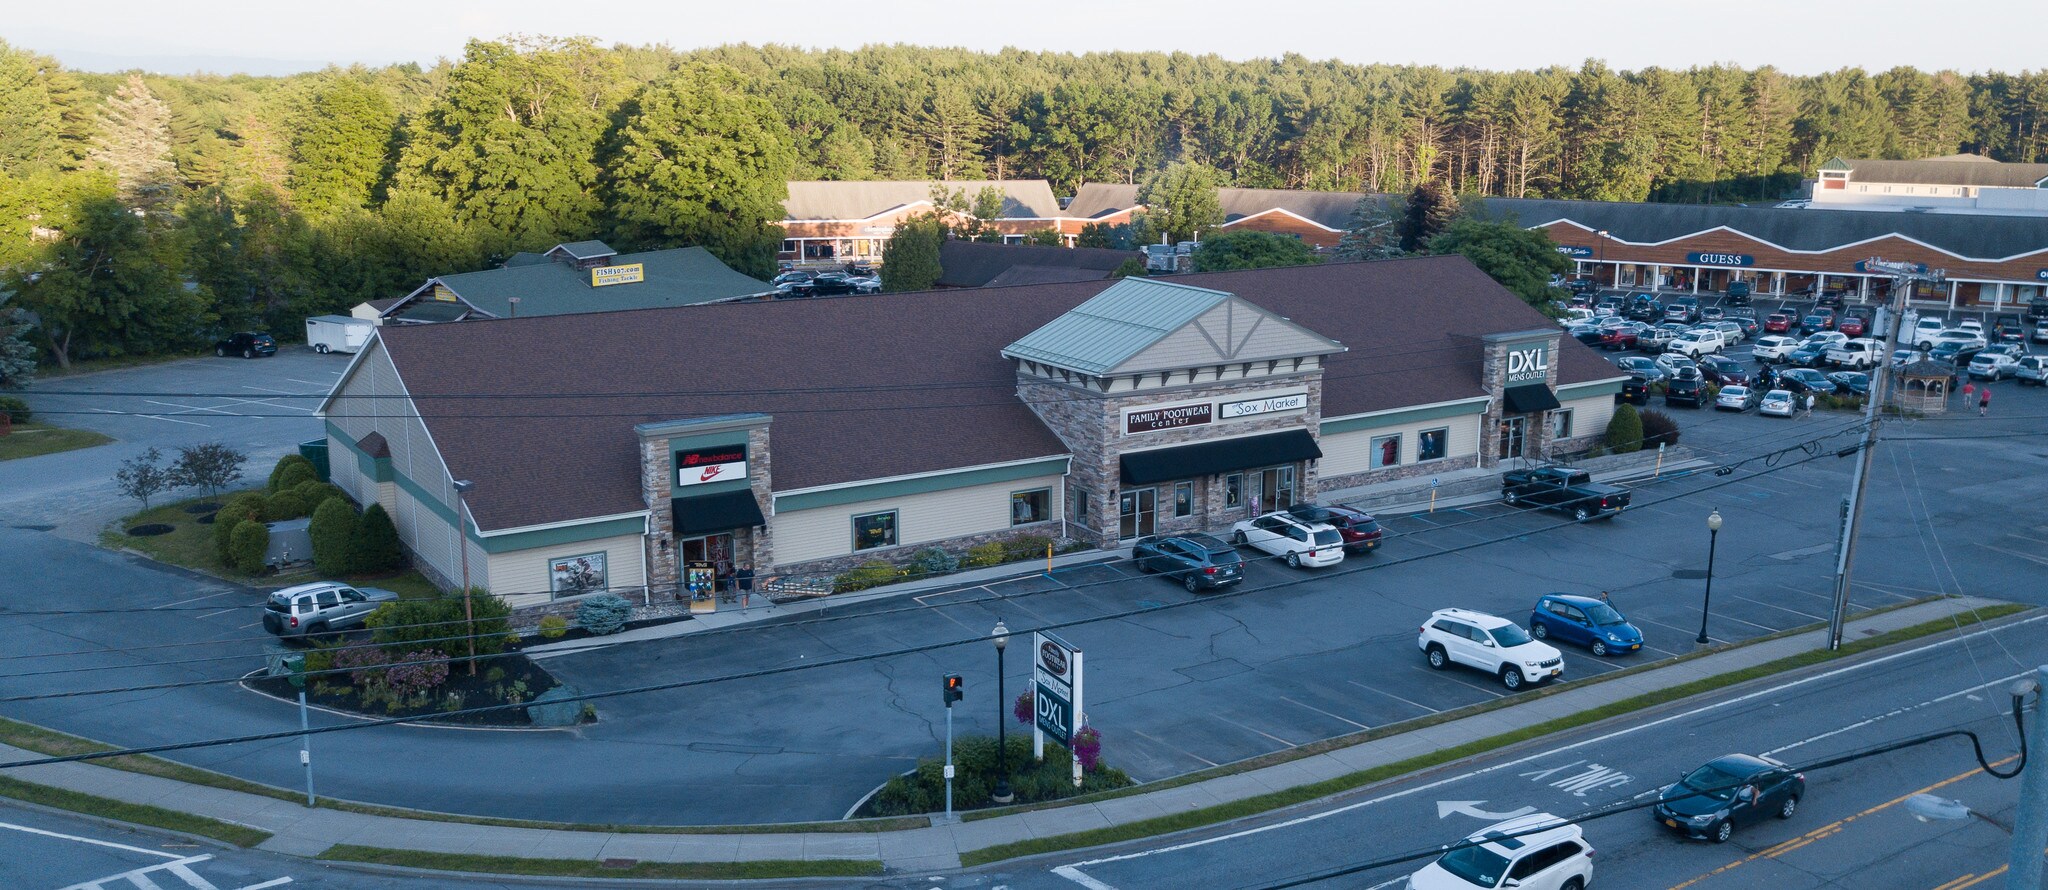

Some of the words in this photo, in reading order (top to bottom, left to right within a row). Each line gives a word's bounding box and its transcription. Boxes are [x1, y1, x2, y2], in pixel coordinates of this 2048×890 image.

[1700, 253, 1742, 265] GUESS
[1508, 348, 1547, 374] DXL
[1509, 373, 1525, 382] MENS
[1525, 370, 1546, 380] OUTLET
[1236, 402, 1258, 415] Sox
[1262, 398, 1299, 413] Market
[1130, 410, 1161, 424] FAMILY
[1163, 405, 1210, 420] FOOTWEAR
[1151, 416, 1190, 428] center
[704, 465, 720, 475] NIKE
[1039, 692, 1067, 732] DXL
